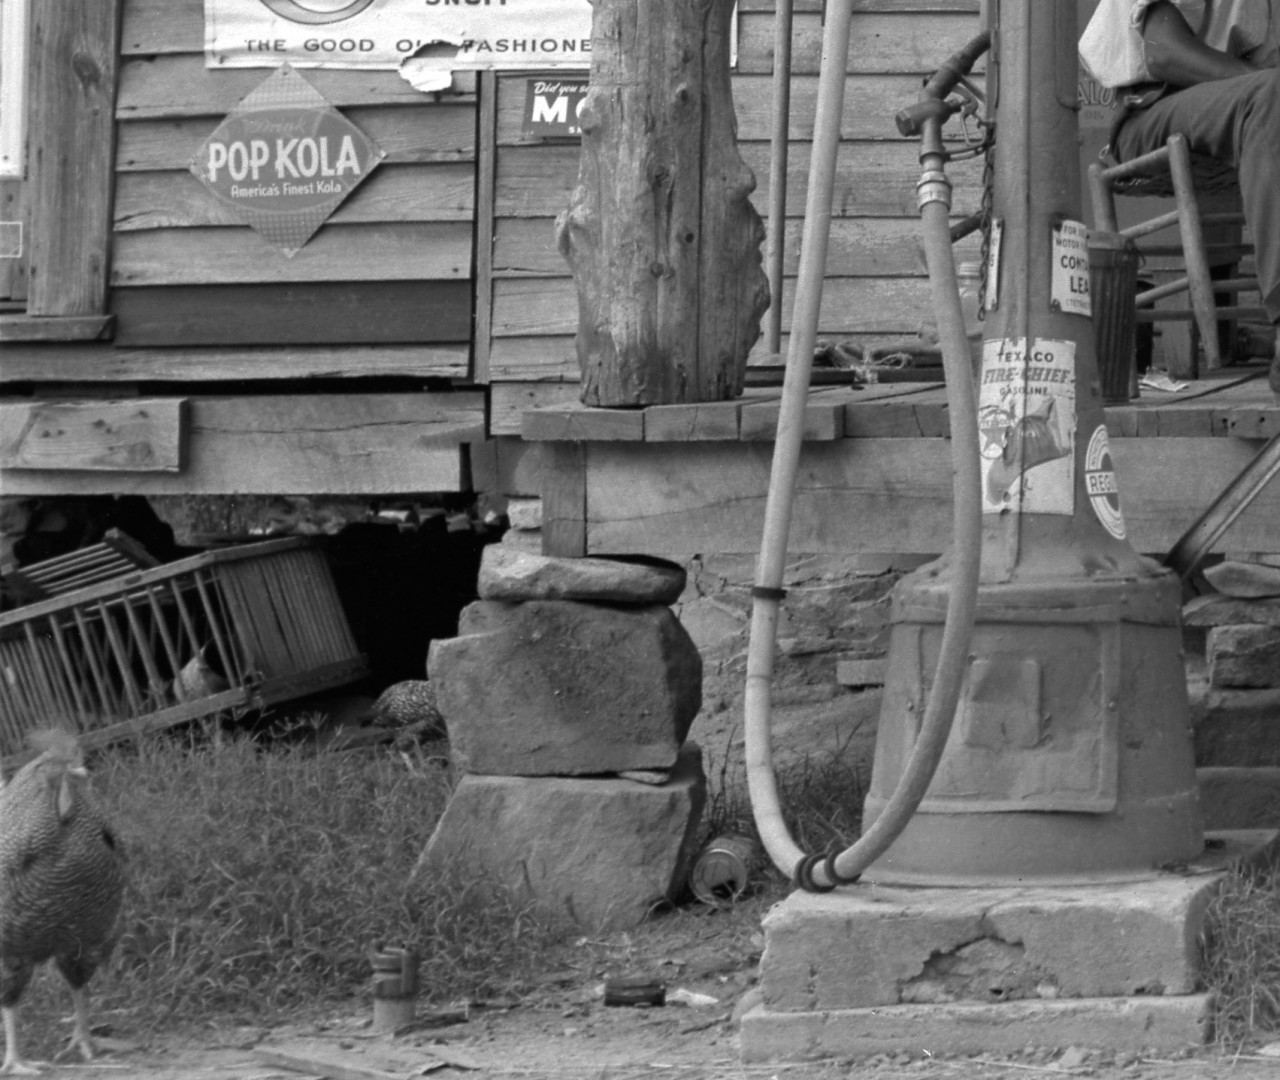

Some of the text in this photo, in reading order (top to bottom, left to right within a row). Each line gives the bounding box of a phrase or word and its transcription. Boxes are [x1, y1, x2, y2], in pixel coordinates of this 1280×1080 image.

[245, 38, 288, 52] THE
[303, 38, 375, 53] GOOD
[534, 81, 559, 95] Did
[207, 135, 361, 183] POP KOLA
[230, 180, 342, 199] America's Finest Kola
[1070, 275, 1089, 293] LEA
[997, 351, 1054, 363] TEXACO
[1000, 386, 1049, 396] GASOLINE
